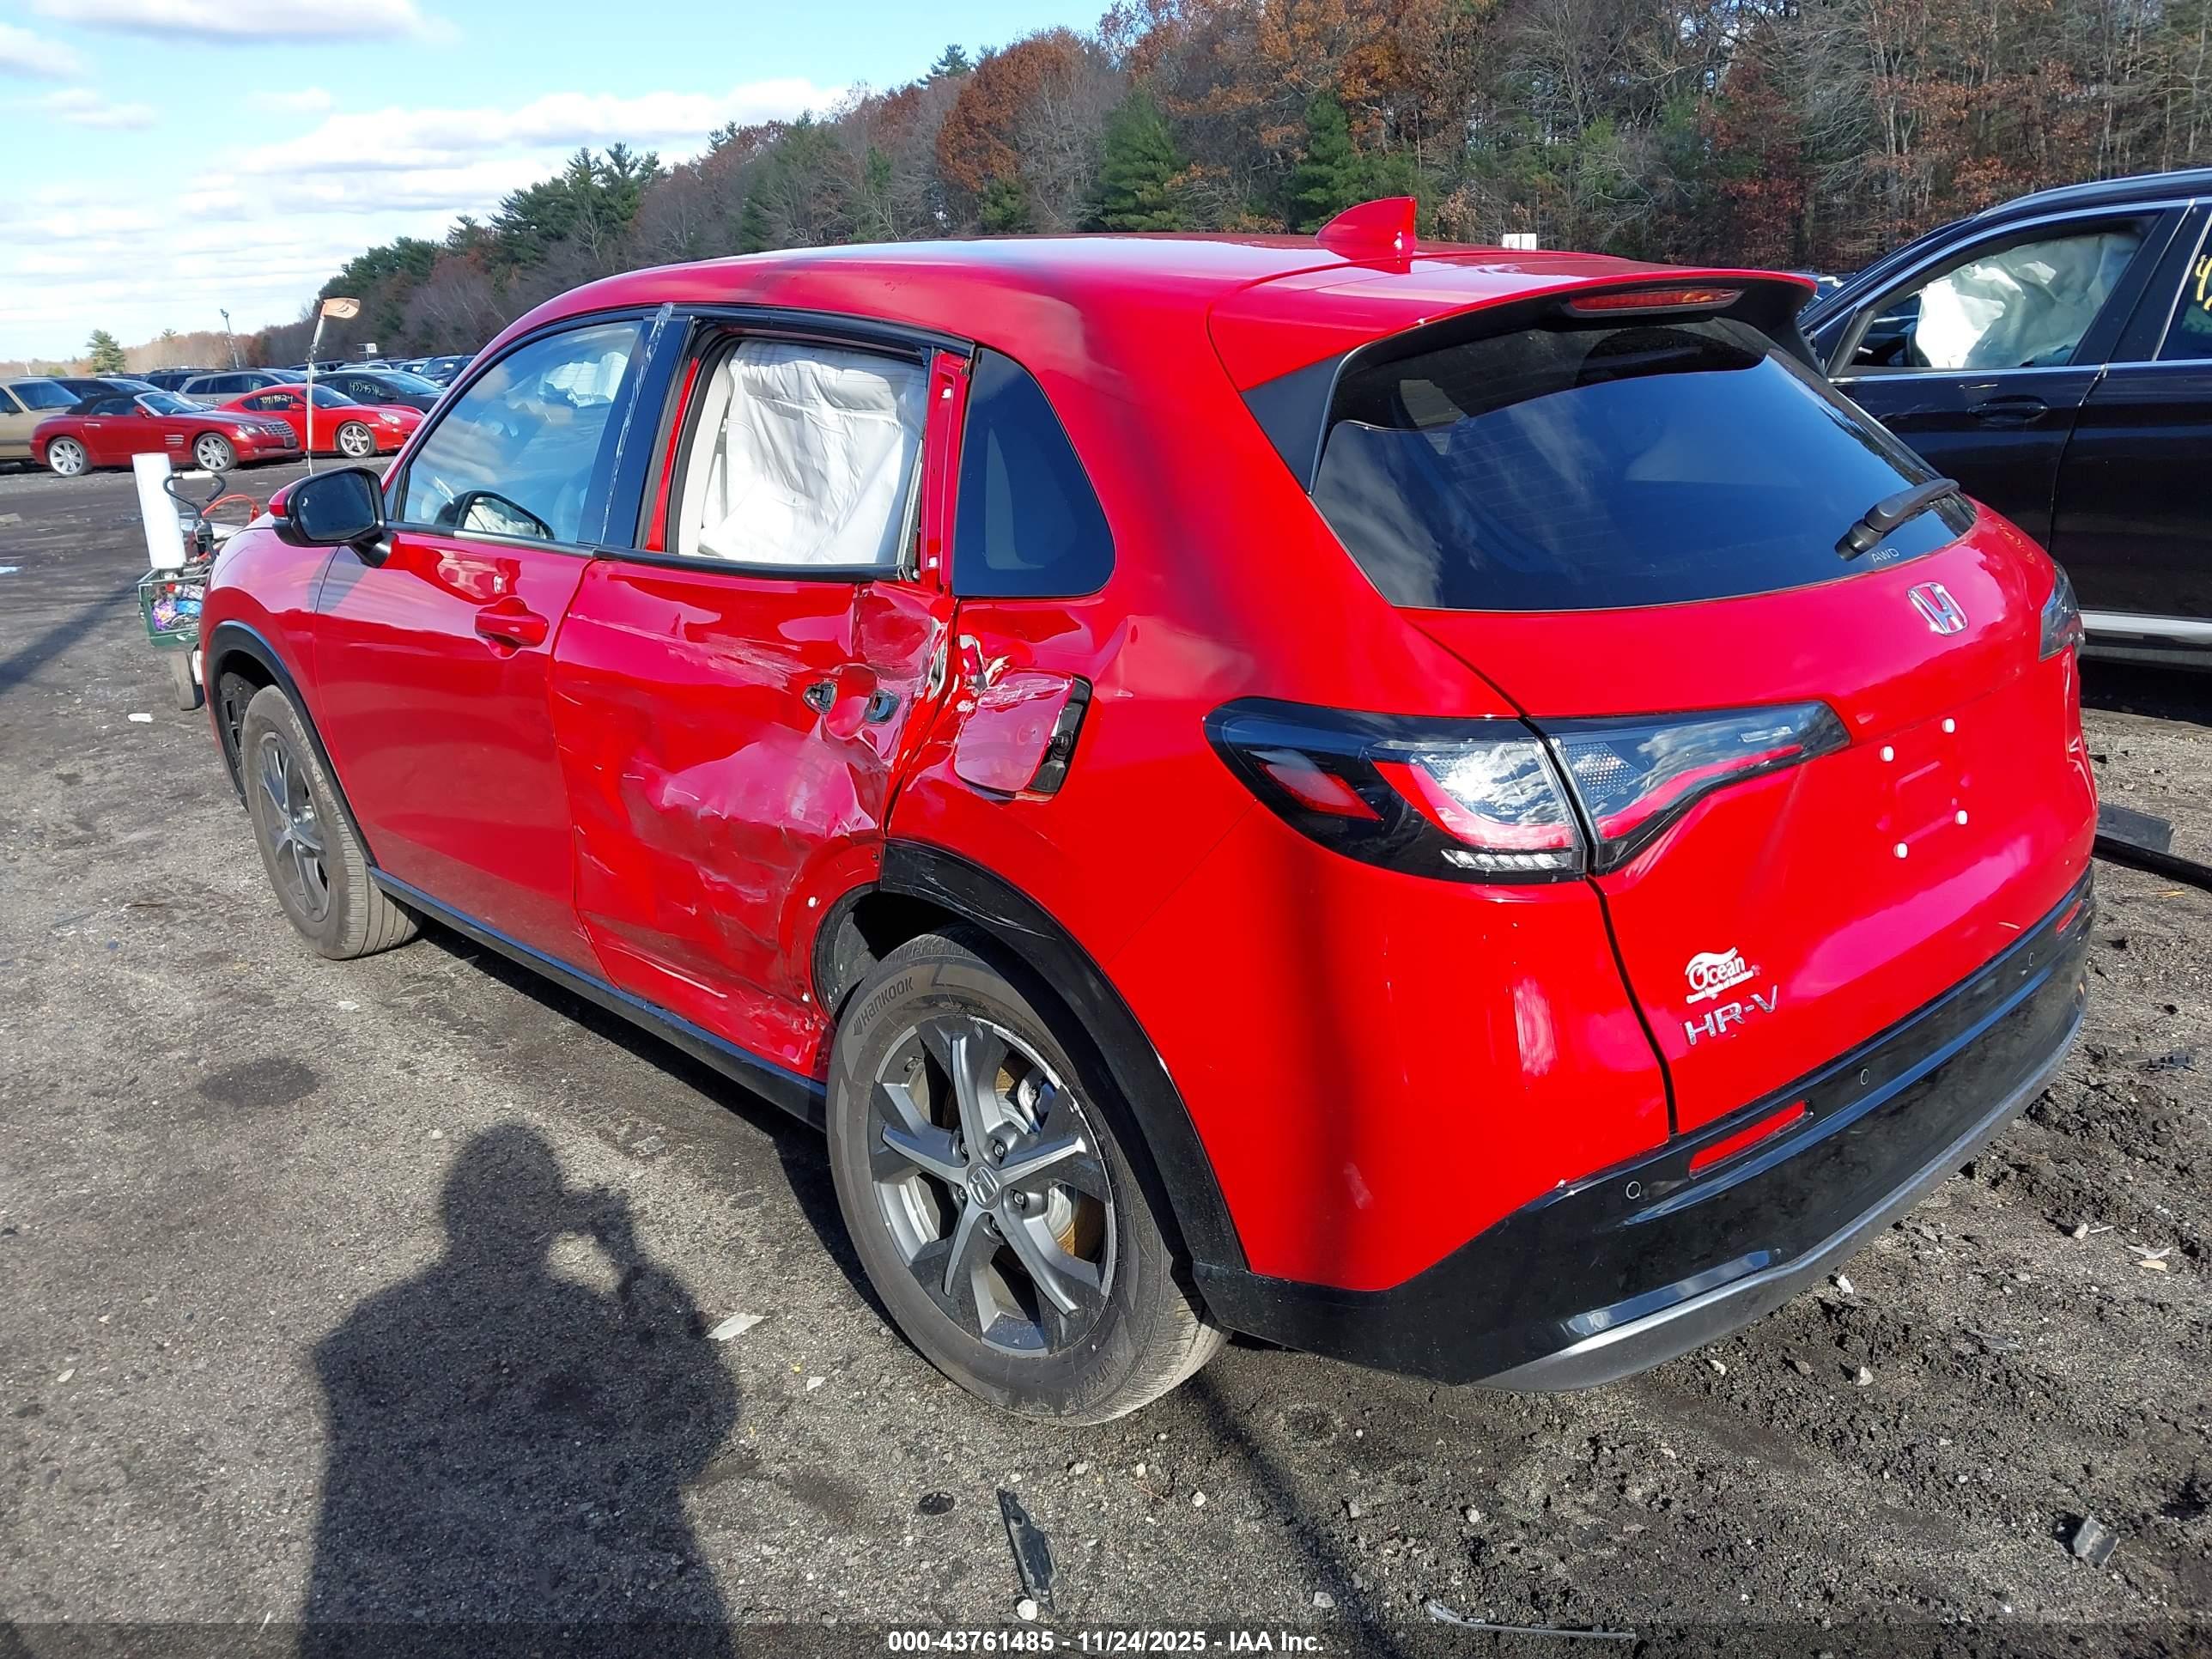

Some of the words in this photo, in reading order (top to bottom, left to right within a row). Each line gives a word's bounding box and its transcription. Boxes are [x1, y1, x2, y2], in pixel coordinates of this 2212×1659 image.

[1871, 548, 1899, 563] AWD
[1689, 956, 1745, 990] Ocean
[1684, 984, 1778, 1046] HR-V
